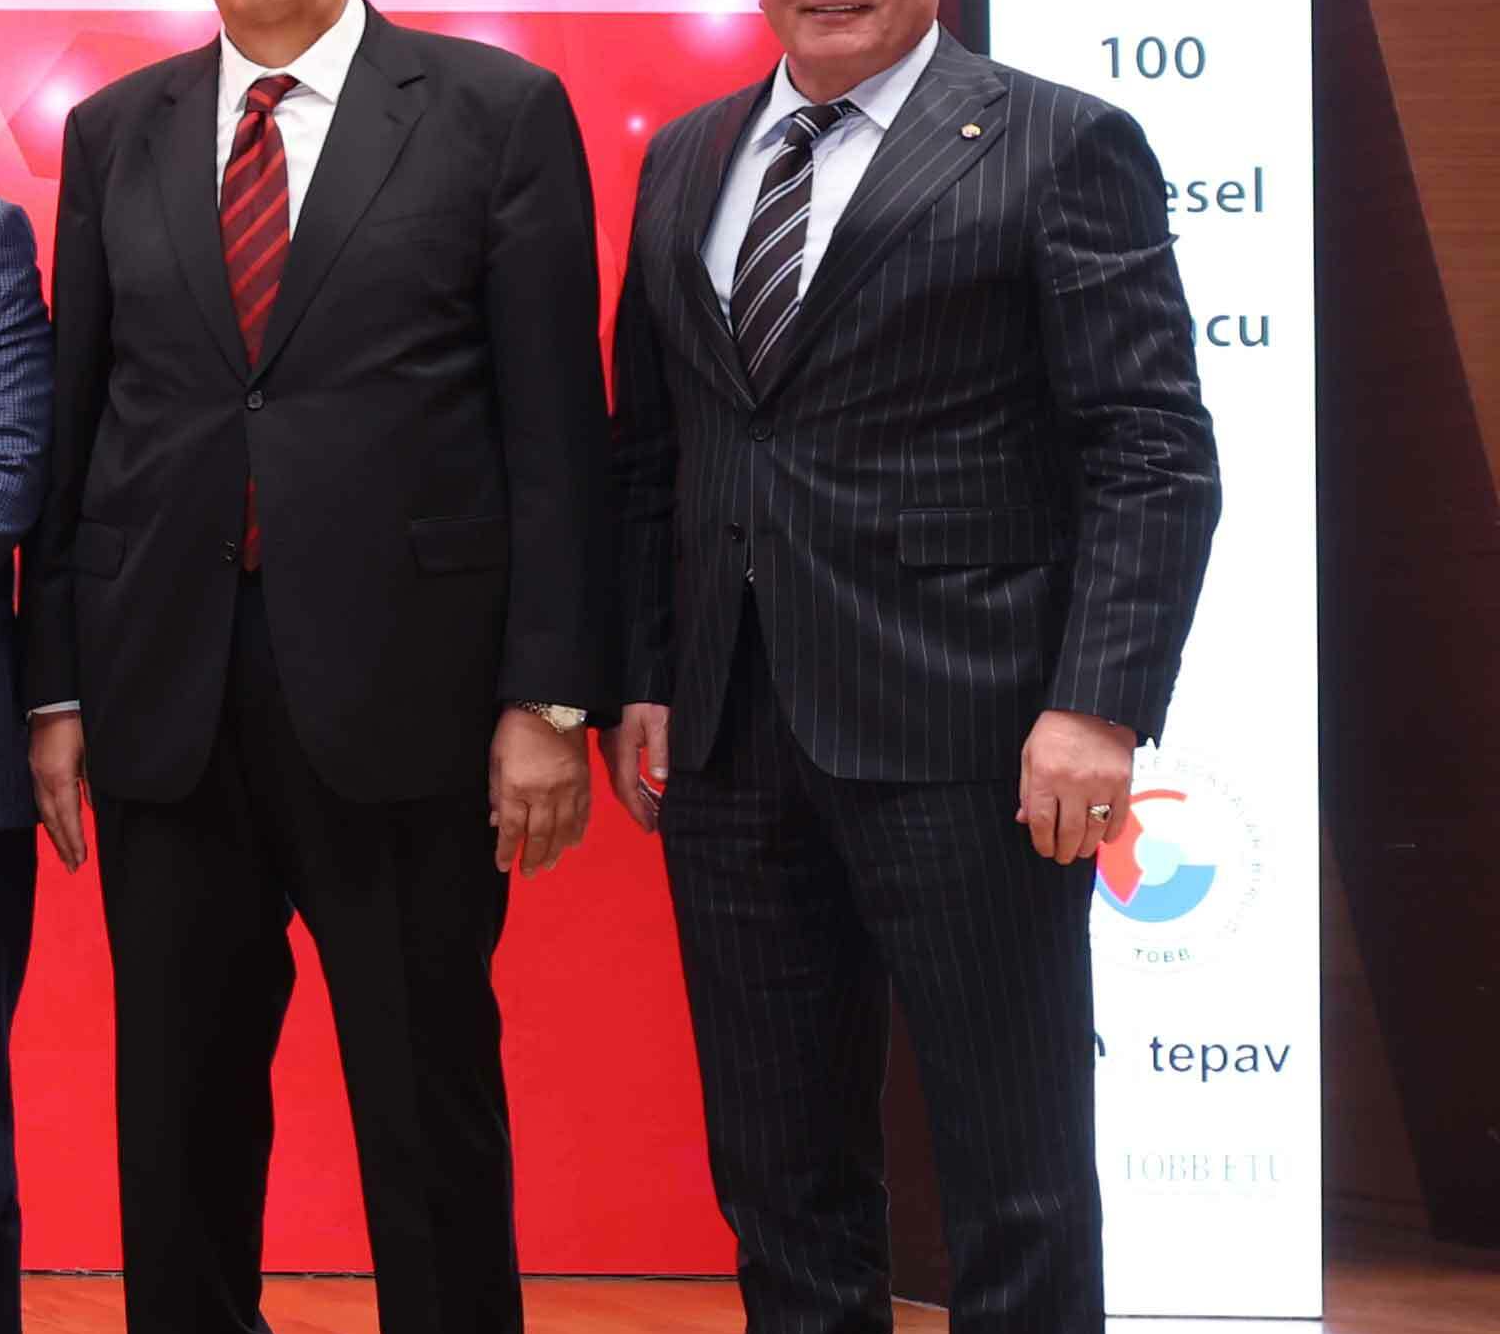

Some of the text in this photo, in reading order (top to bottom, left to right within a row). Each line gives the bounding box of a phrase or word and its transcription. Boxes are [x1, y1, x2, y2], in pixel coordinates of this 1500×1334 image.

[1101, 36, 1206, 79] 100
[1164, 166, 1263, 213] esel
[1149, 1035, 1291, 1083] tepav
